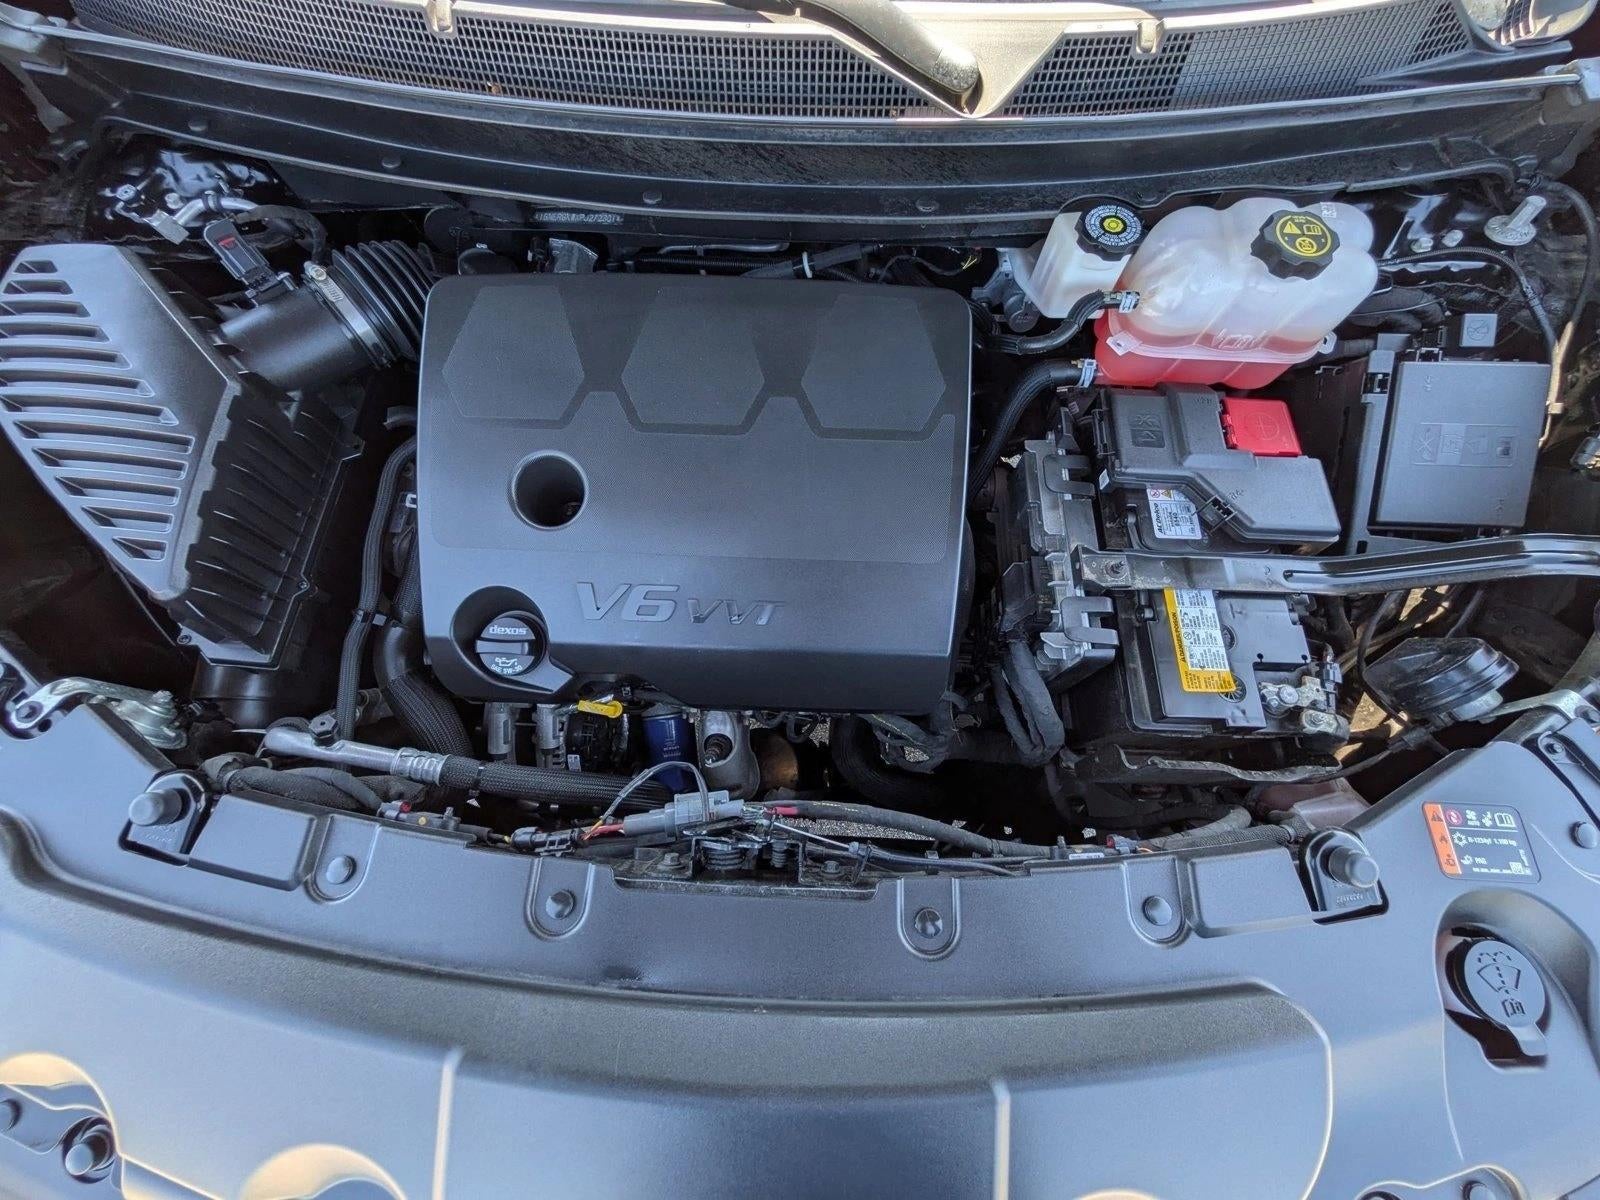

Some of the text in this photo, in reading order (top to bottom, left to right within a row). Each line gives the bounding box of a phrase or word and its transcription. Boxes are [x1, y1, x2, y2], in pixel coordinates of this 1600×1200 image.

[1153, 502, 1164, 534] ACDelco
[576, 581, 787, 626] V6 VVT
[488, 624, 529, 636] dexos
[490, 664, 503, 673] SAE
